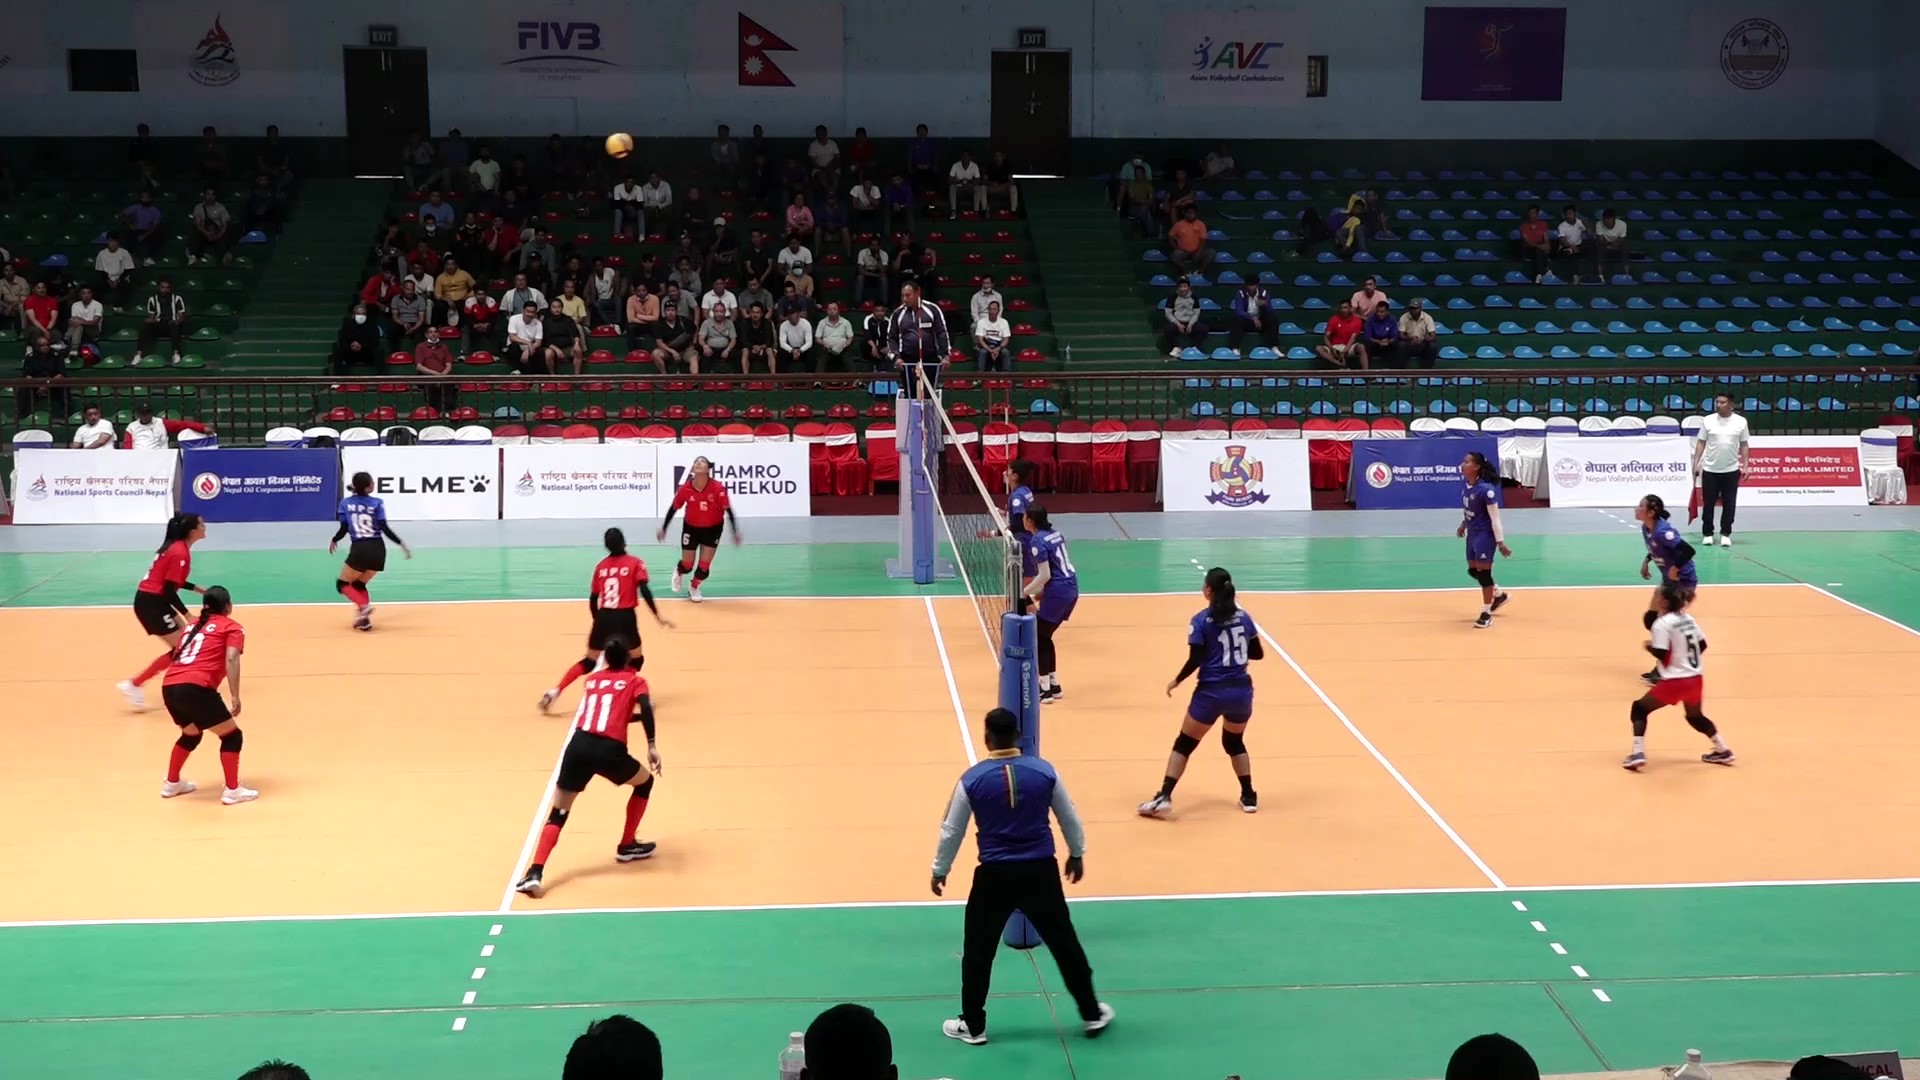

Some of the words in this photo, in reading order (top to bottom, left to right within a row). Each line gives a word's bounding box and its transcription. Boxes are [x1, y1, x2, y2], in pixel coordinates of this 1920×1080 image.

[372, 31, 393, 43] EXIT
[518, 22, 601, 50] FIVB
[1023, 33, 1042, 44] EXIT
[1210, 42, 1284, 69] AVC
[1209, 74, 1240, 83] Volleyball
[712, 465, 781, 478] HAMRO
[1585, 460, 1617, 473] नेपाल
[1621, 459, 1664, 473] भलिबल
[1668, 461, 1687, 473] संघ
[222, 476, 241, 486] नेपाल
[632, 471, 653, 480] नेपाल
[1424, 475, 1460, 483] Corporation
[1585, 475, 1607, 483] Nepal
[1608, 475, 1643, 484] Volleyball
[1645, 474, 1687, 482] Association
[223, 486, 242, 495] Nepal
[255, 486, 293, 495] Corporation
[295, 485, 320, 493] Limited
[377, 477, 466, 494] ELME
[541, 483, 573, 491] National
[574, 483, 598, 492] Sports
[723, 481, 797, 494] HELKUD
[54, 488, 87, 496] National
[89, 488, 113, 497] Sports
[347, 503, 376, 514] NPC
[699, 501, 708, 511] 6
[682, 533, 691, 545] 6
[599, 567, 629, 578] NPC
[603, 577, 620, 609] 8
[163, 614, 177, 629] 5
[184, 623, 217, 634] NC
[1218, 625, 1249, 667] 15
[1686, 634, 1699, 669] 5
[585, 679, 627, 691] NPC
[1022, 673, 1032, 709] Senoh
[582, 693, 614, 732] 11
